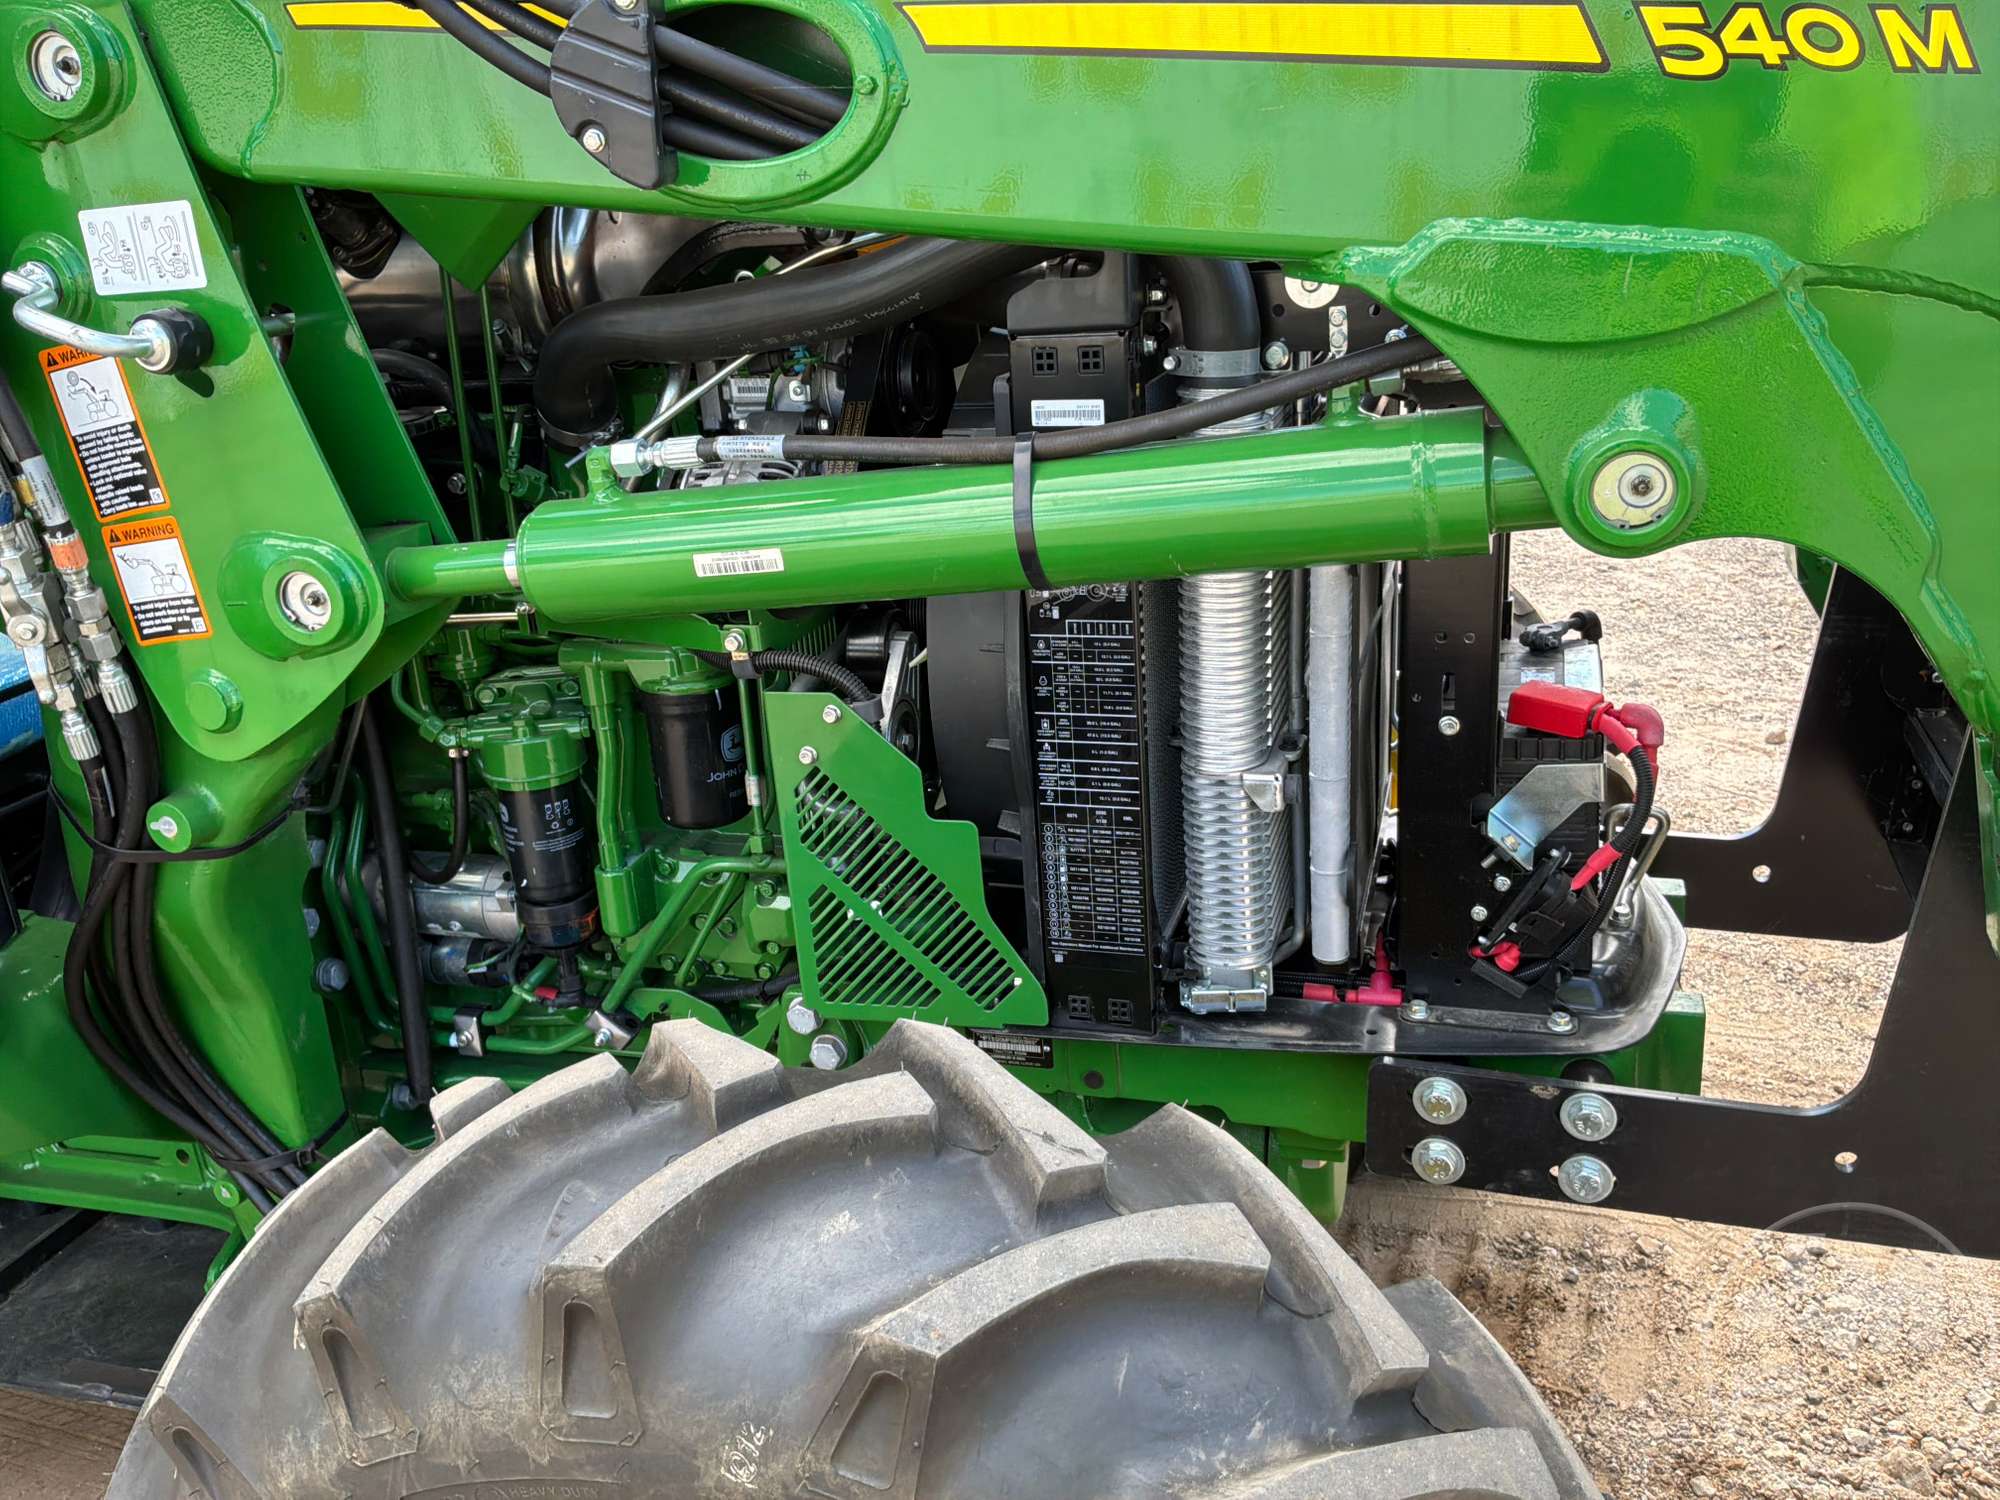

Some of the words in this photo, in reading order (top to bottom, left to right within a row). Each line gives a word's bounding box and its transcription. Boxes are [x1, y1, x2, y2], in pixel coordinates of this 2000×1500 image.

[1635, 4, 1863, 80] 540
[1870, 5, 1979, 73] M
[121, 523, 175, 541] WARNING
[706, 767, 737, 783] JOHN
